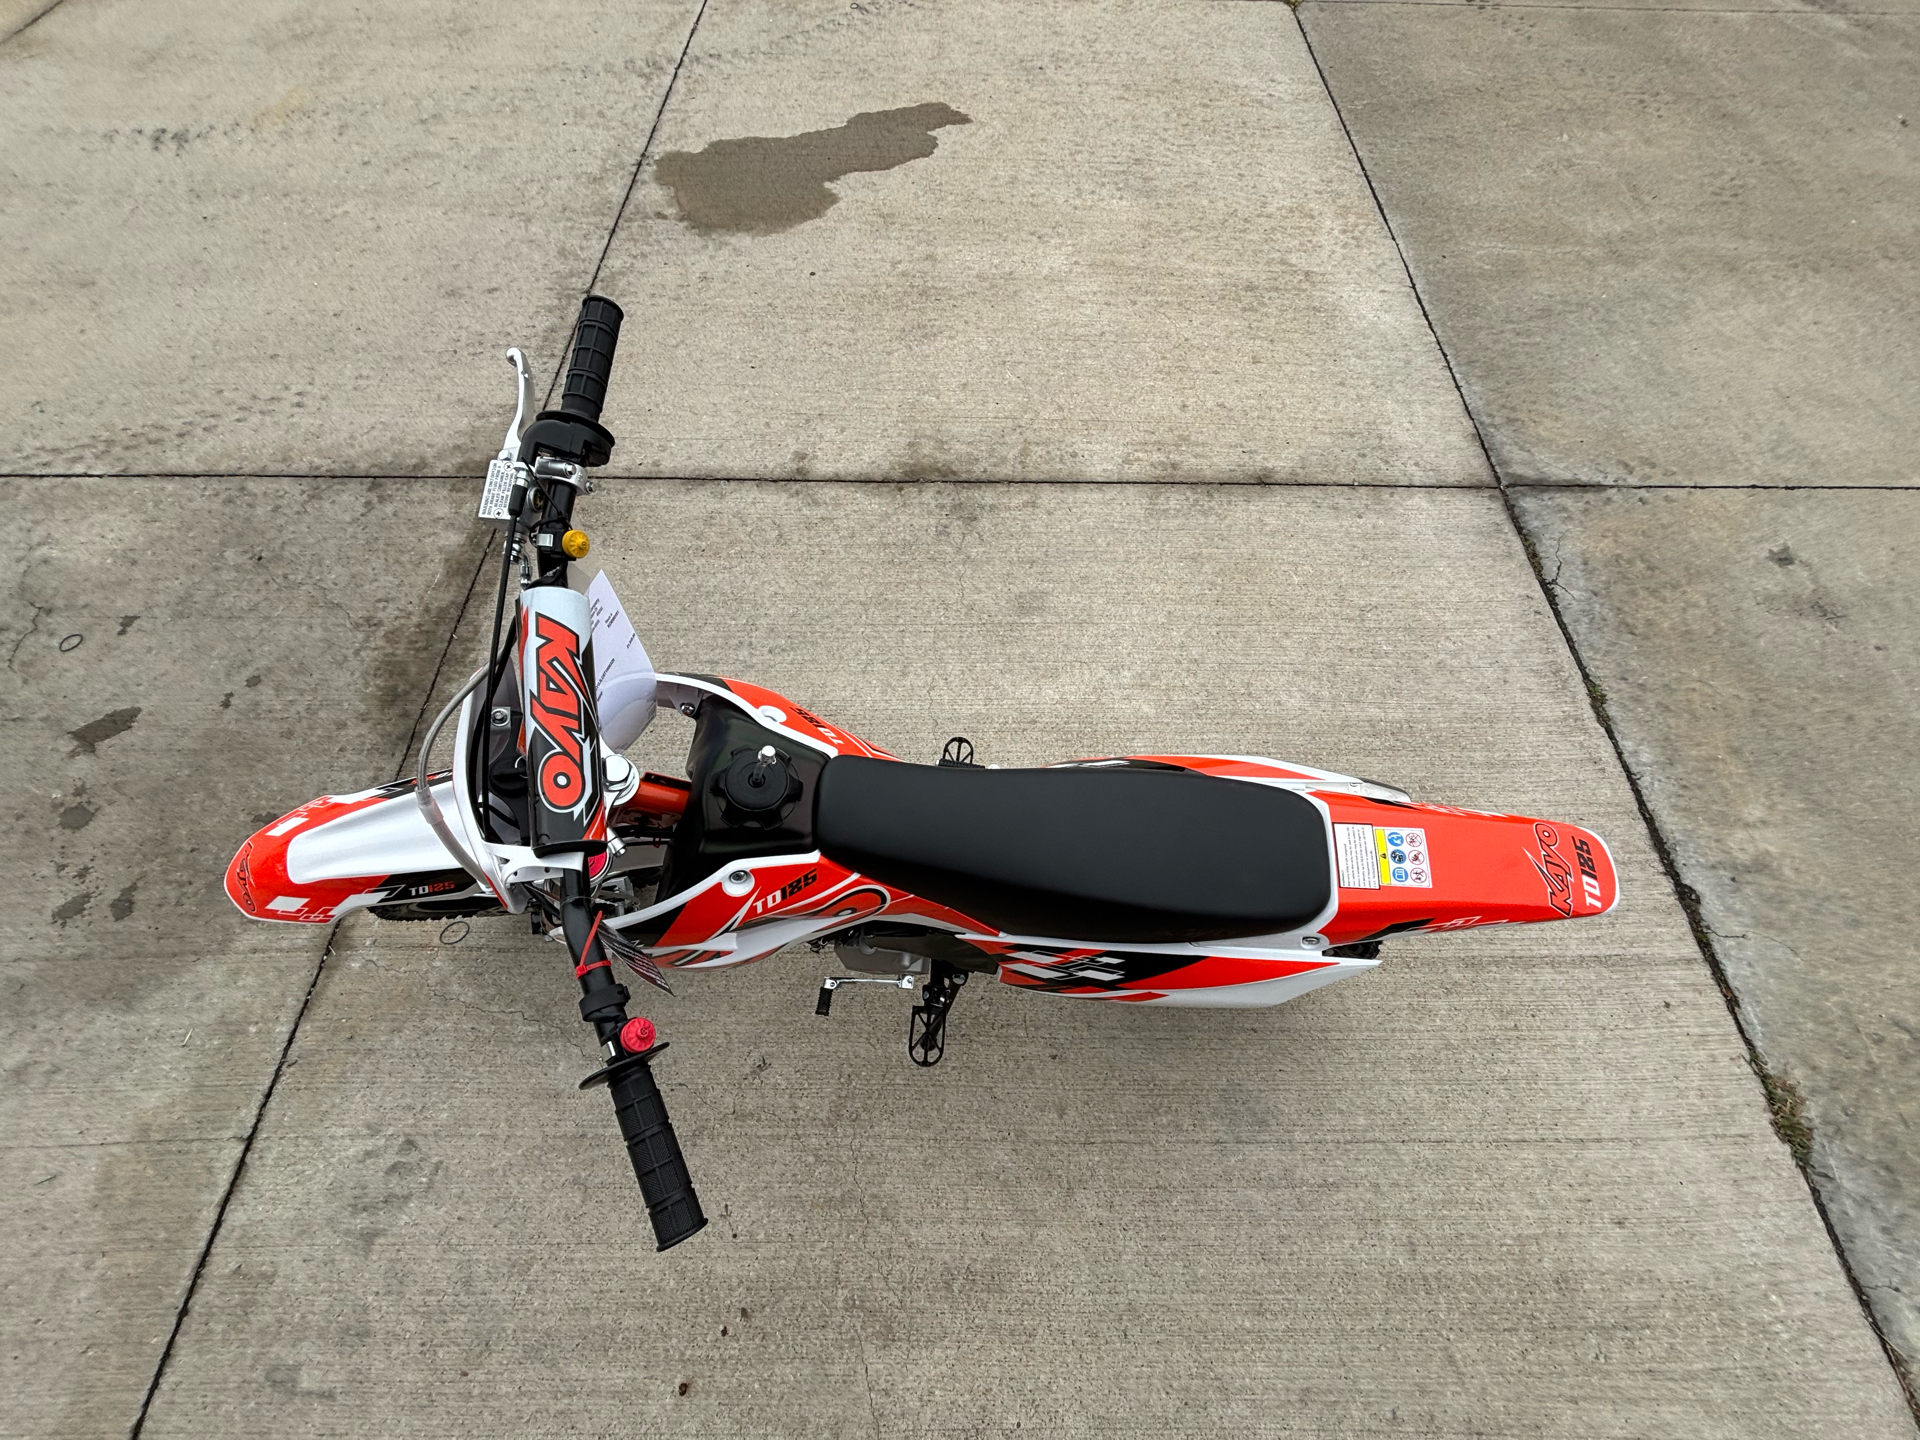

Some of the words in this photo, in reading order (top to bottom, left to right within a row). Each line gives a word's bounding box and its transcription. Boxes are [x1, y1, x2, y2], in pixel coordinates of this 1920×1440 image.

[530, 611, 588, 812] KAYO
[408, 881, 455, 897] TD125
[753, 868, 818, 914] TD125
[1531, 822, 1573, 917] KAYO
[1571, 836, 1602, 908] TD125
